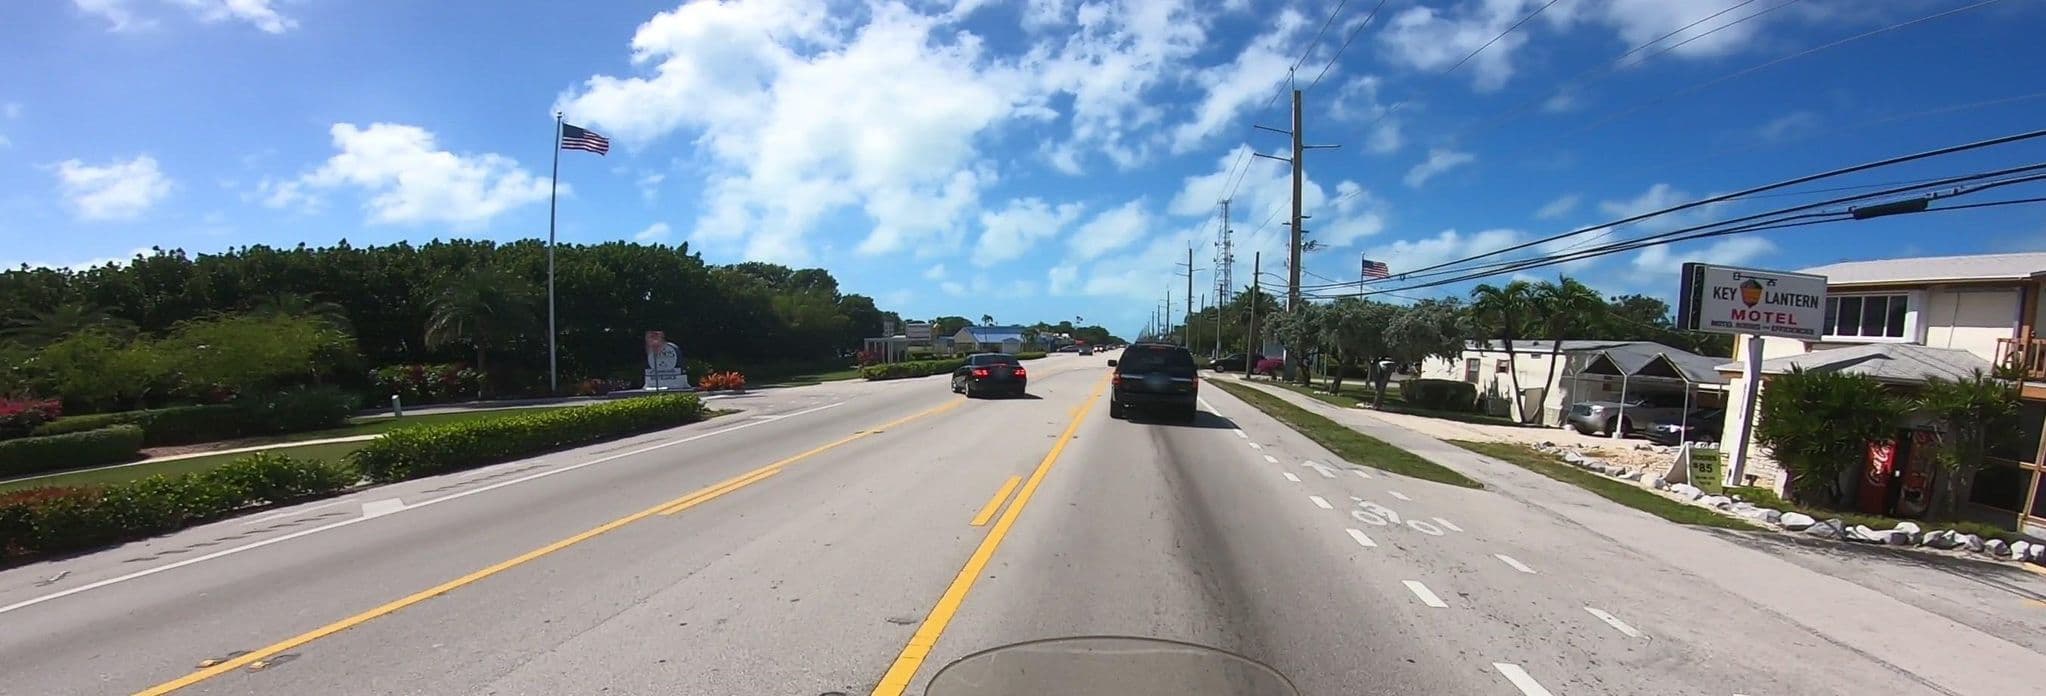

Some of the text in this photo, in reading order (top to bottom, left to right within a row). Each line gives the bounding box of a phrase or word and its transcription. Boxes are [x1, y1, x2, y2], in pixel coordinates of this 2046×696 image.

[1713, 286, 1819, 309] KEY LANTERN
[1731, 308, 1798, 325] MOTEL
